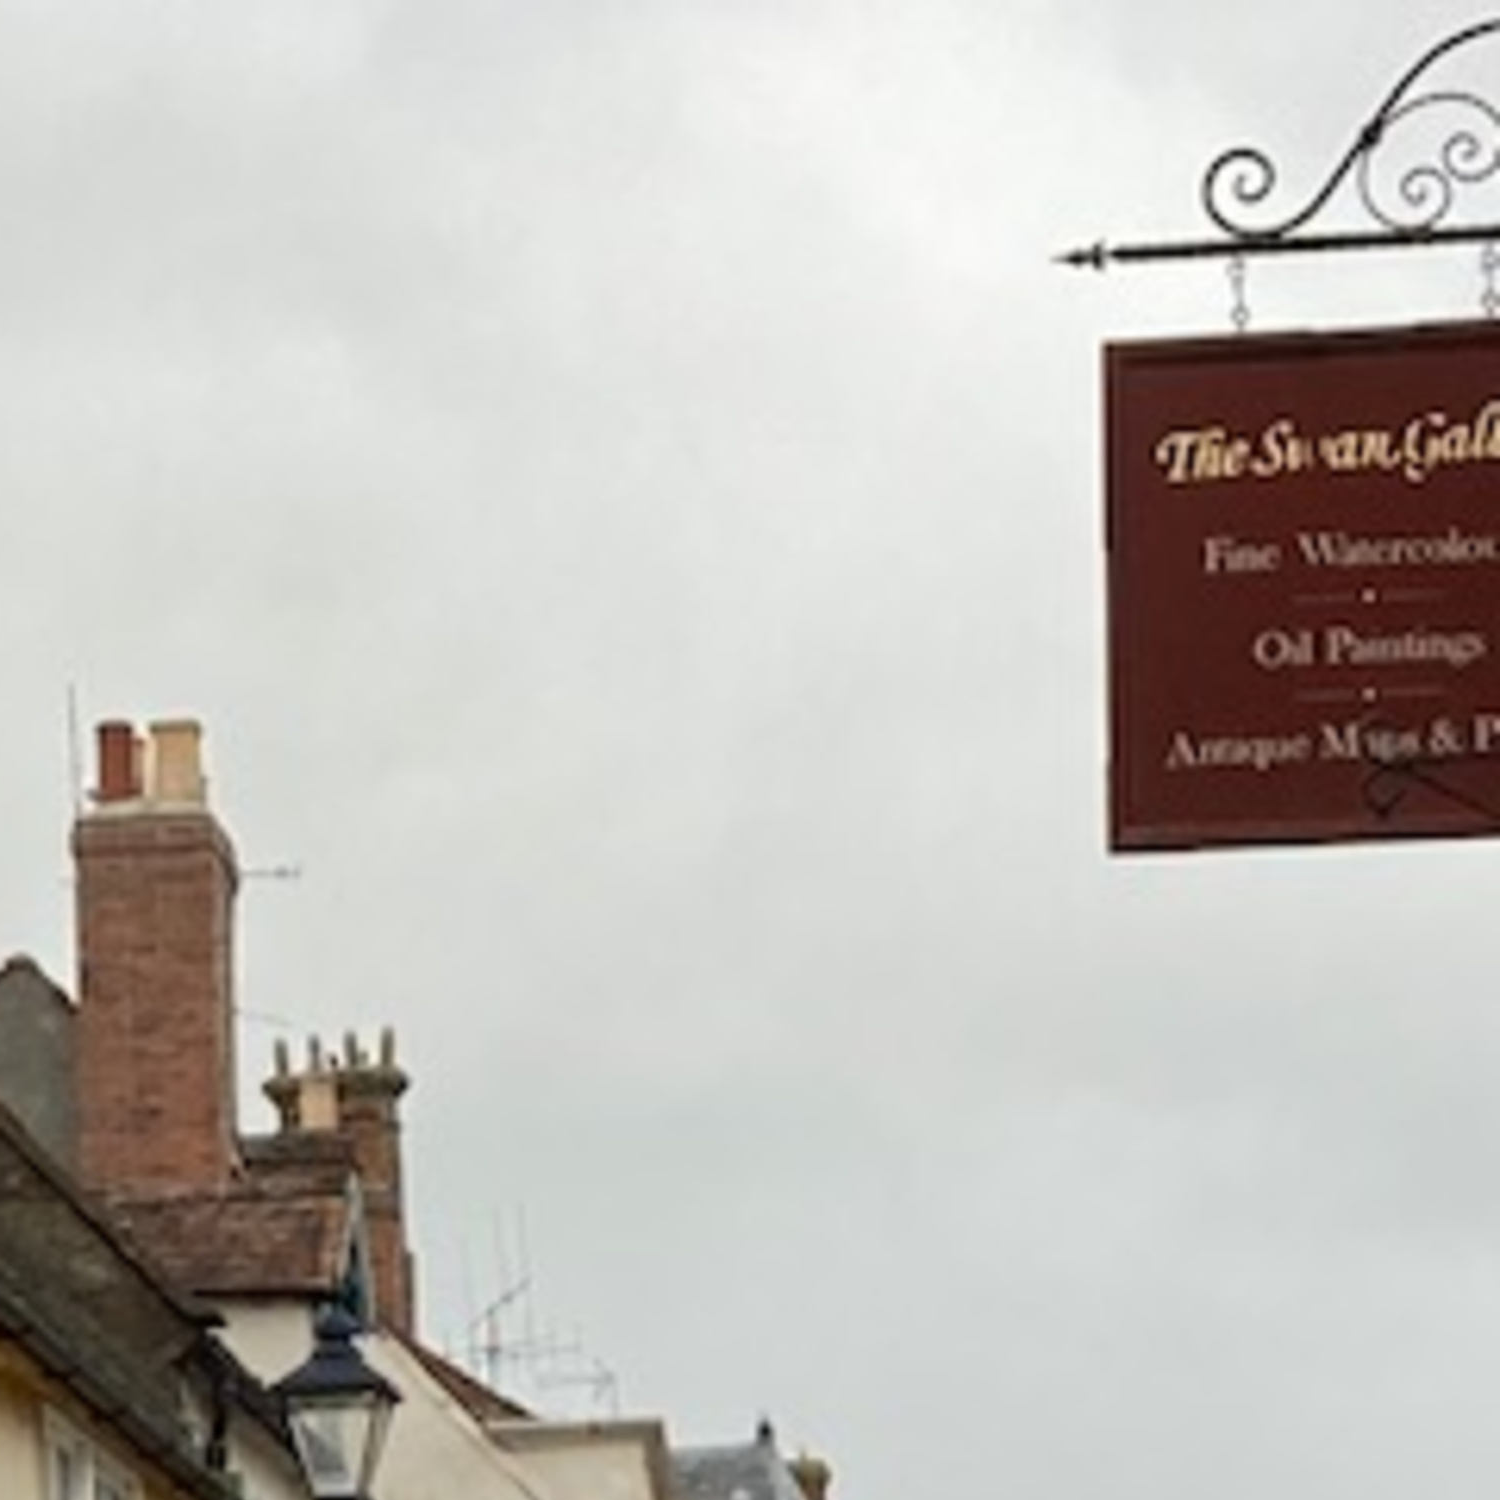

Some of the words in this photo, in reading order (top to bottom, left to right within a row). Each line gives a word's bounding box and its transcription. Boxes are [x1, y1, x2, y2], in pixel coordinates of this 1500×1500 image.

[1155, 427, 1250, 482] The
[1250, 419, 1400, 477] Swan
[1203, 536, 1280, 574] Fine
[1252, 629, 1315, 669] Oil
[1325, 626, 1488, 666] Paintings
[1165, 732, 1311, 771] Antique
[1428, 717, 1465, 756] &
